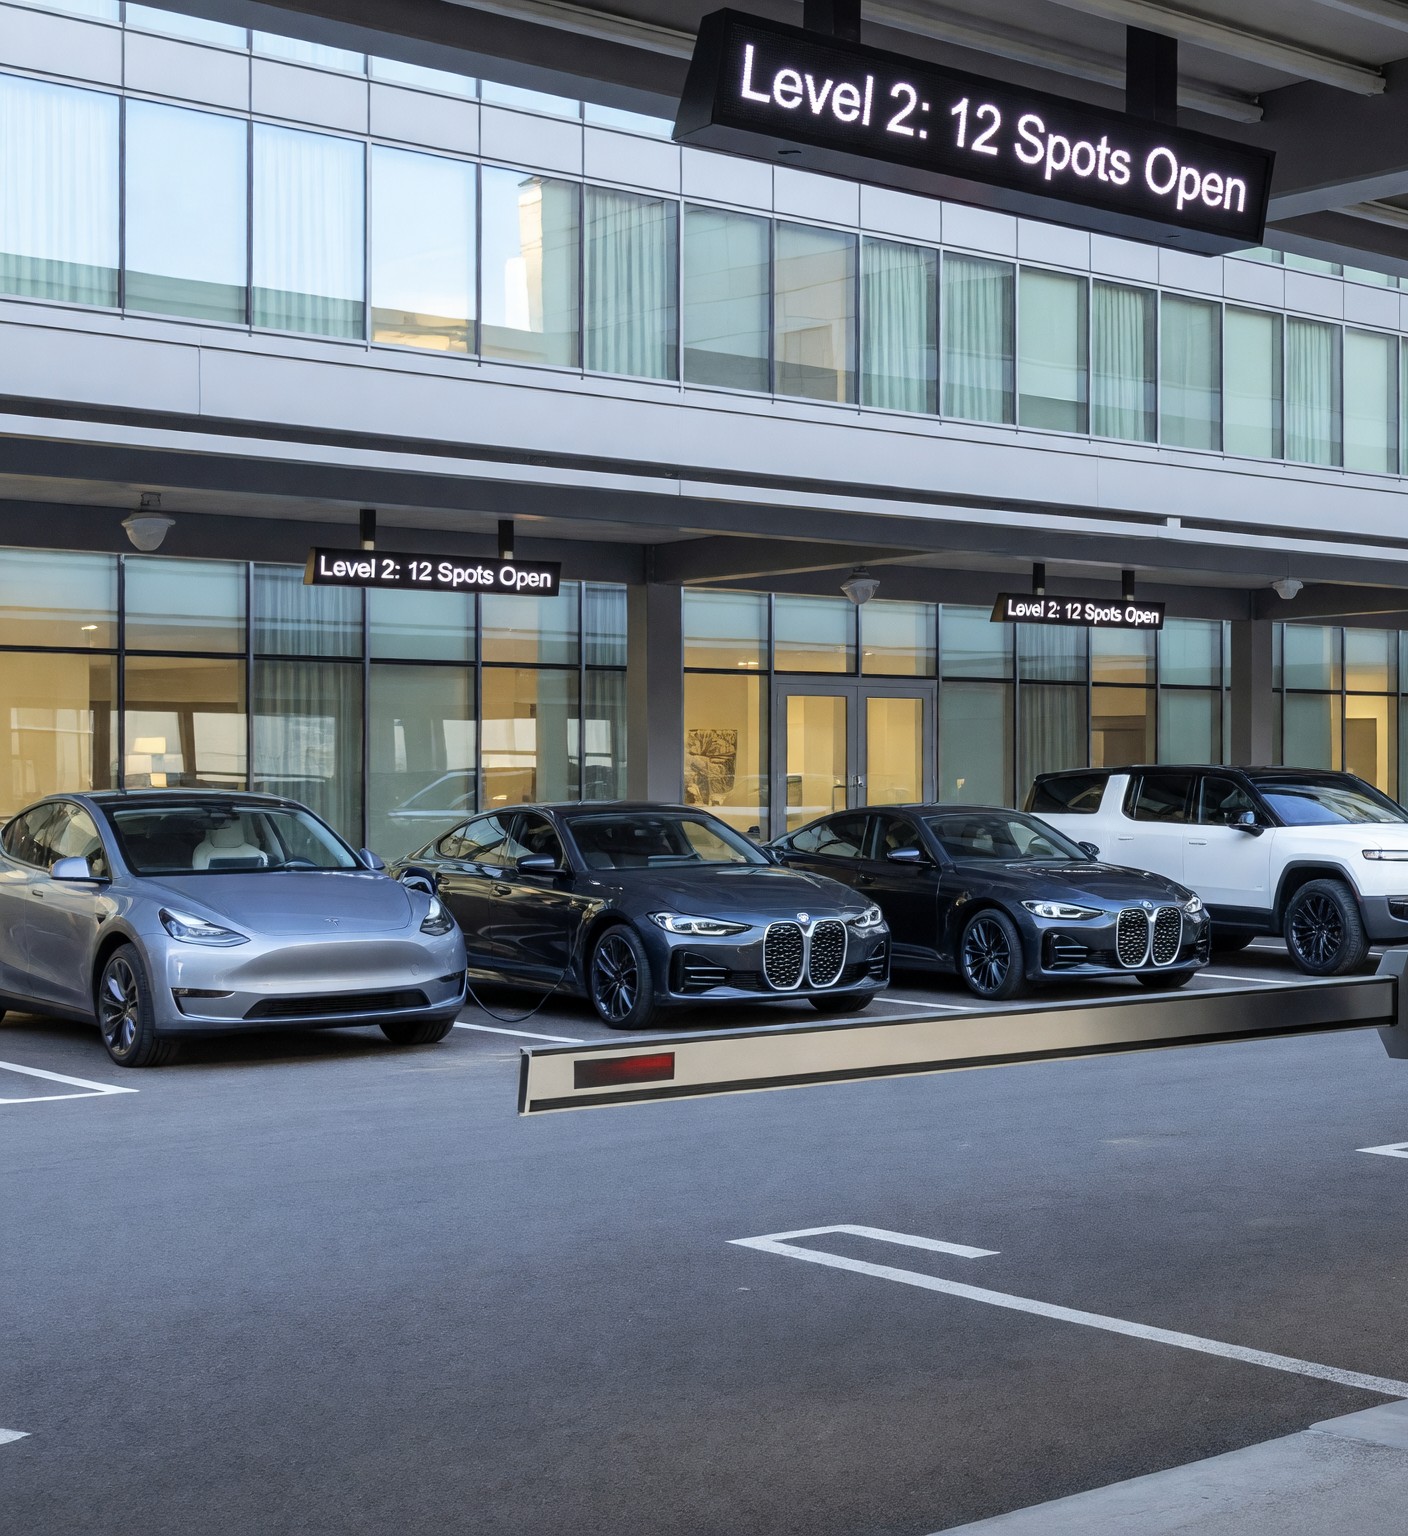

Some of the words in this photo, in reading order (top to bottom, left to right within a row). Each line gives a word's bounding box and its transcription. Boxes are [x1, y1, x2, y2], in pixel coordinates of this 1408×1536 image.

[742, 45, 873, 125] Level
[887, 83, 930, 138] 2:
[952, 98, 1002, 155] 12
[1014, 113, 1131, 185] Spots
[1145, 146, 1246, 212] Open
[320, 556, 375, 578] Level
[381, 559, 401, 579] 2:
[409, 562, 432, 581] 12
[437, 563, 494, 586] Spots
[499, 566, 552, 590] Open
[1007, 599, 1045, 617] Level
[1048, 601, 1060, 619] 2:
[1066, 603, 1081, 619] 12
[1084, 604, 1122, 624] Spots
[1125, 606, 1159, 626] Open
